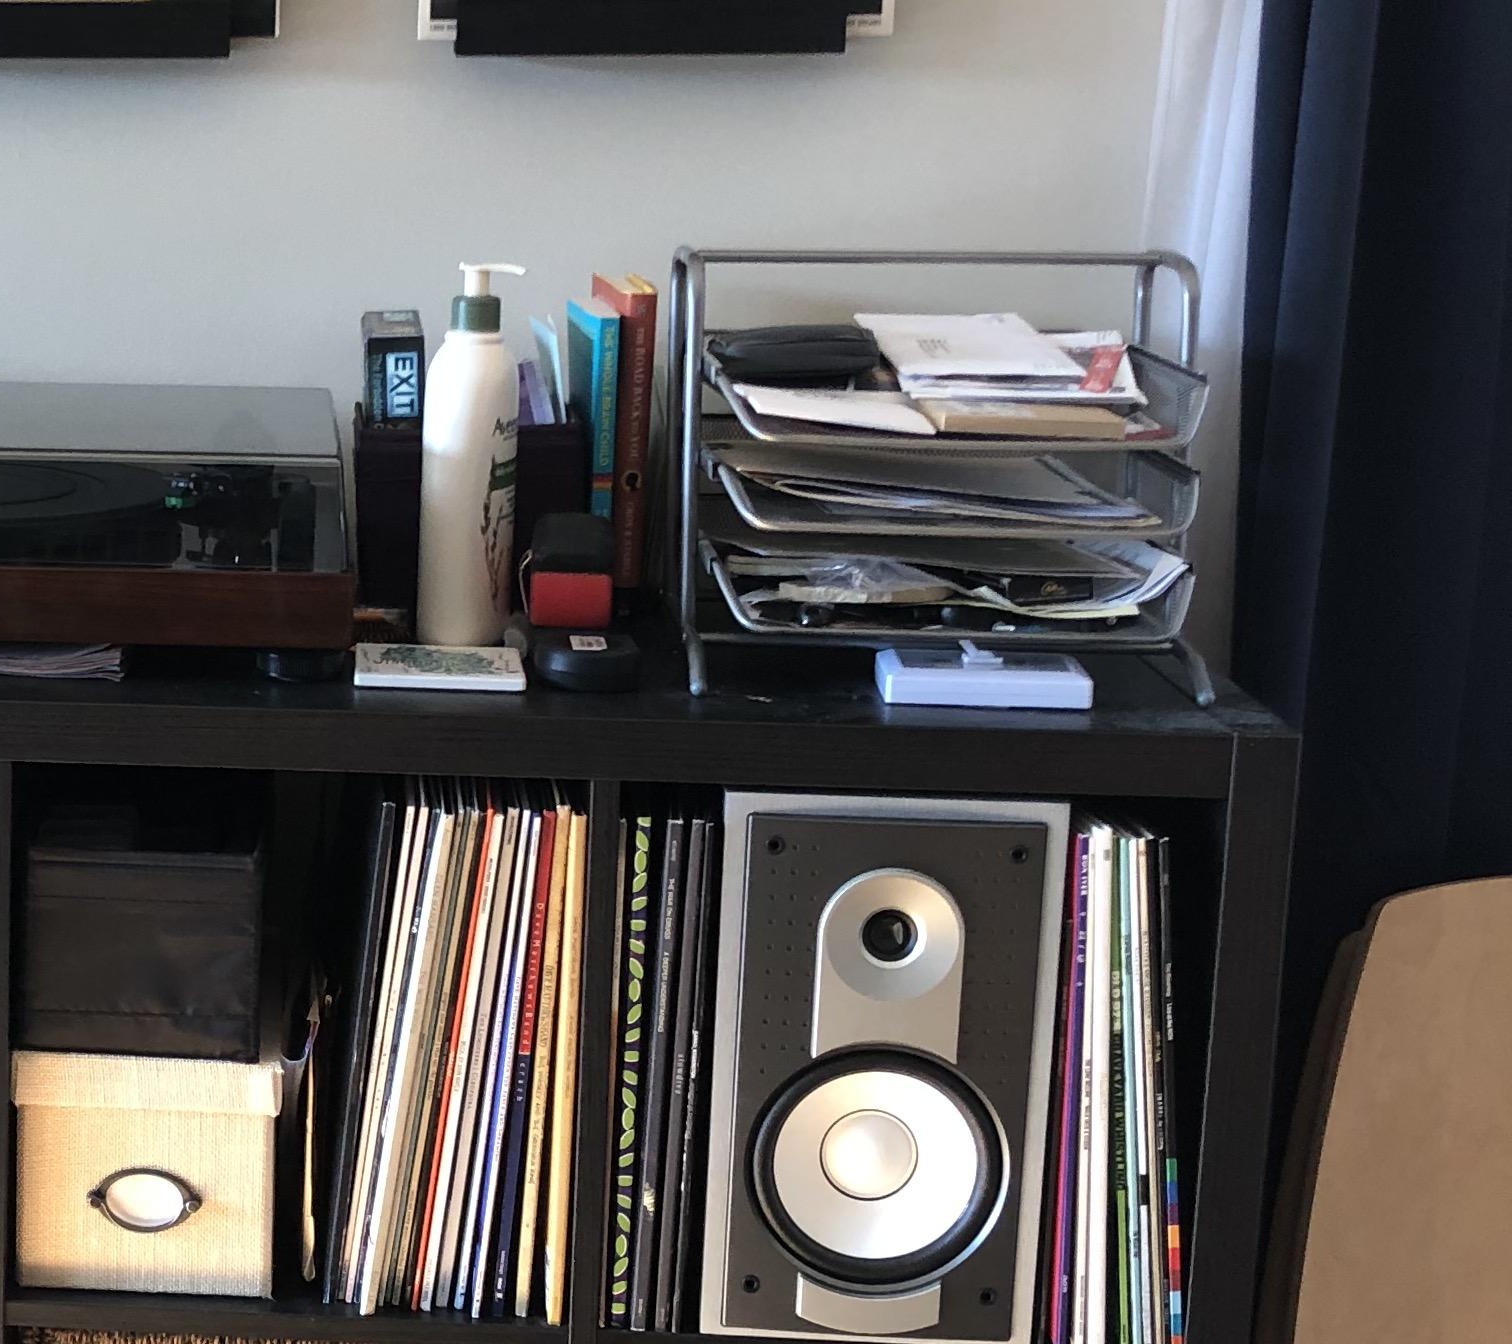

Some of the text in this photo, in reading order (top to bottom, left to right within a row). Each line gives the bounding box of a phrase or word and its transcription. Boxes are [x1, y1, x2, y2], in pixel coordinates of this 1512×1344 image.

[633, 348, 646, 383] ROAD
[390, 357, 414, 413] EXIT
[632, 386, 644, 419] BACK
[599, 432, 609, 466] CHILD
[667, 878, 675, 890] THE
[1080, 875, 1088, 896] IVER
[664, 917, 673, 939] DRUGS
[661, 957, 669, 981] DEEPER
